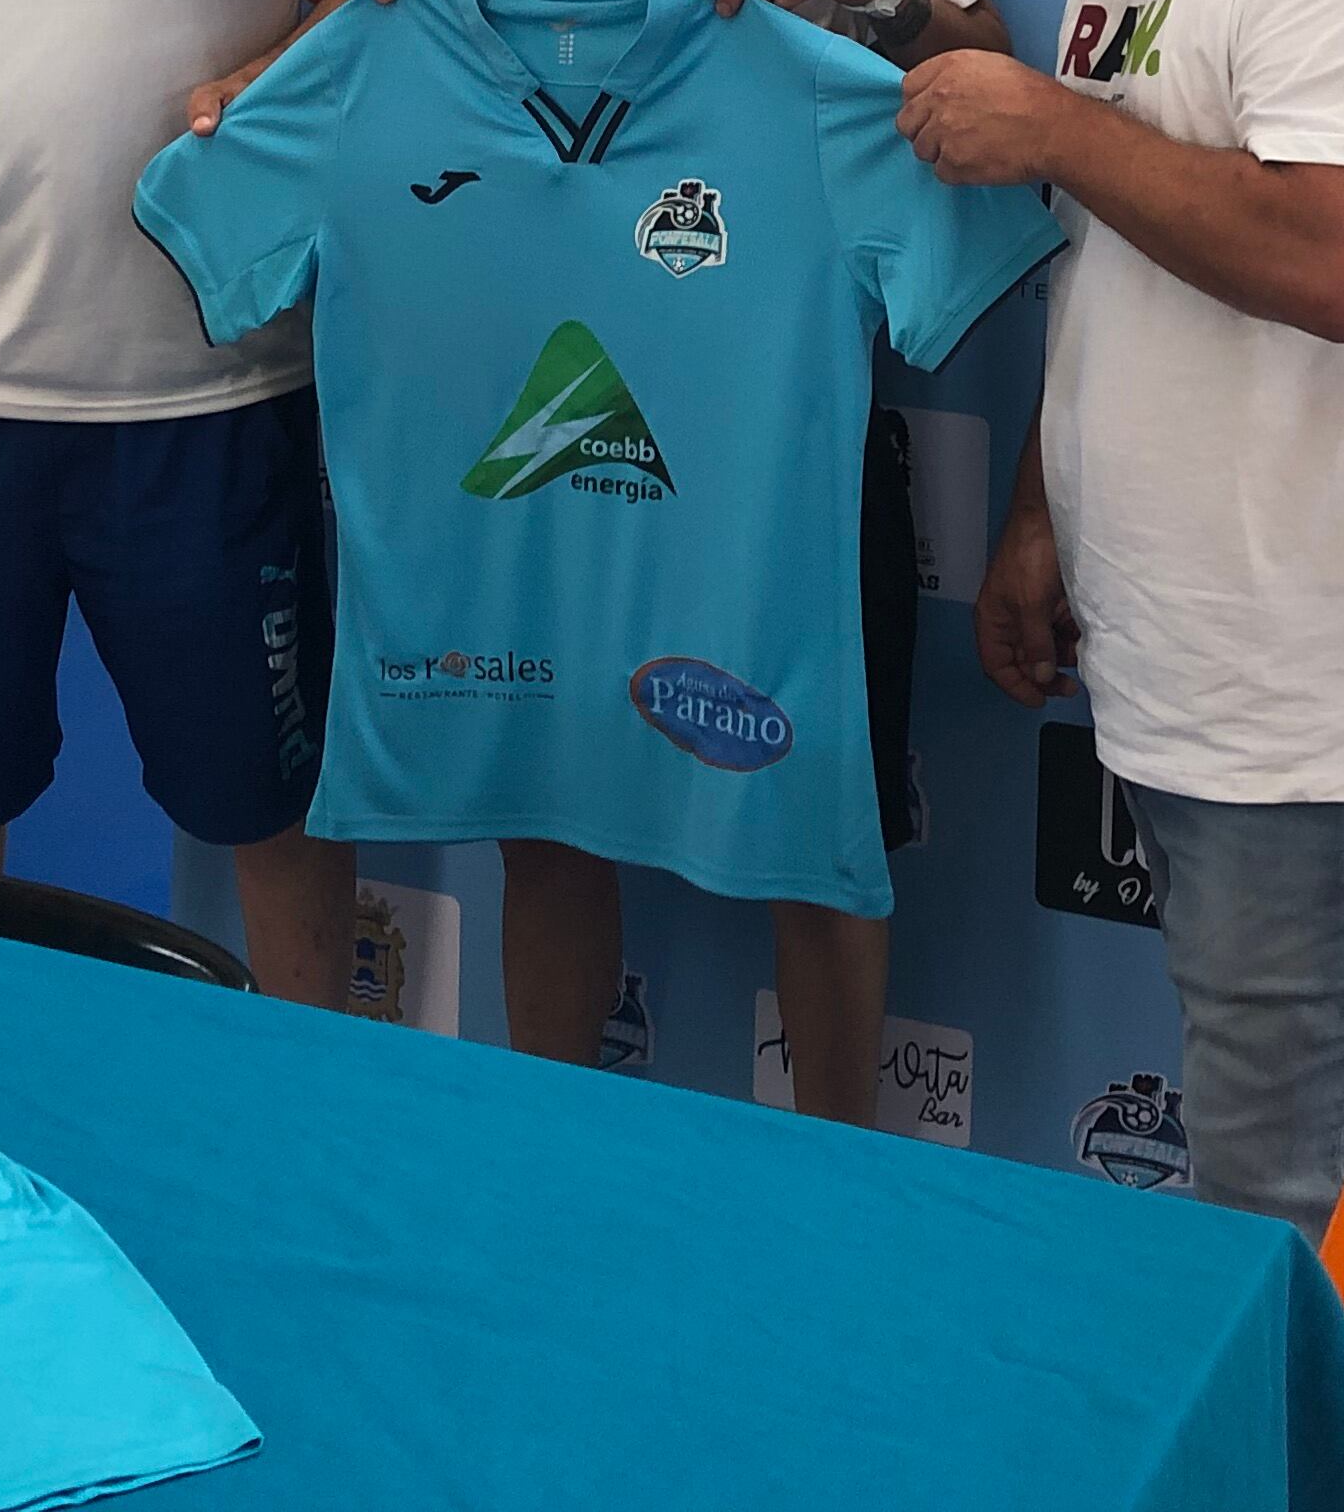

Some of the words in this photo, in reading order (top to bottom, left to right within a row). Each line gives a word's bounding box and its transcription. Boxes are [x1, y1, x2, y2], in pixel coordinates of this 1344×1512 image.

[580, 436, 655, 463] coebb
[571, 472, 663, 504] energía
[380, 657, 416, 681] los
[918, 1096, 964, 1128] Bar
